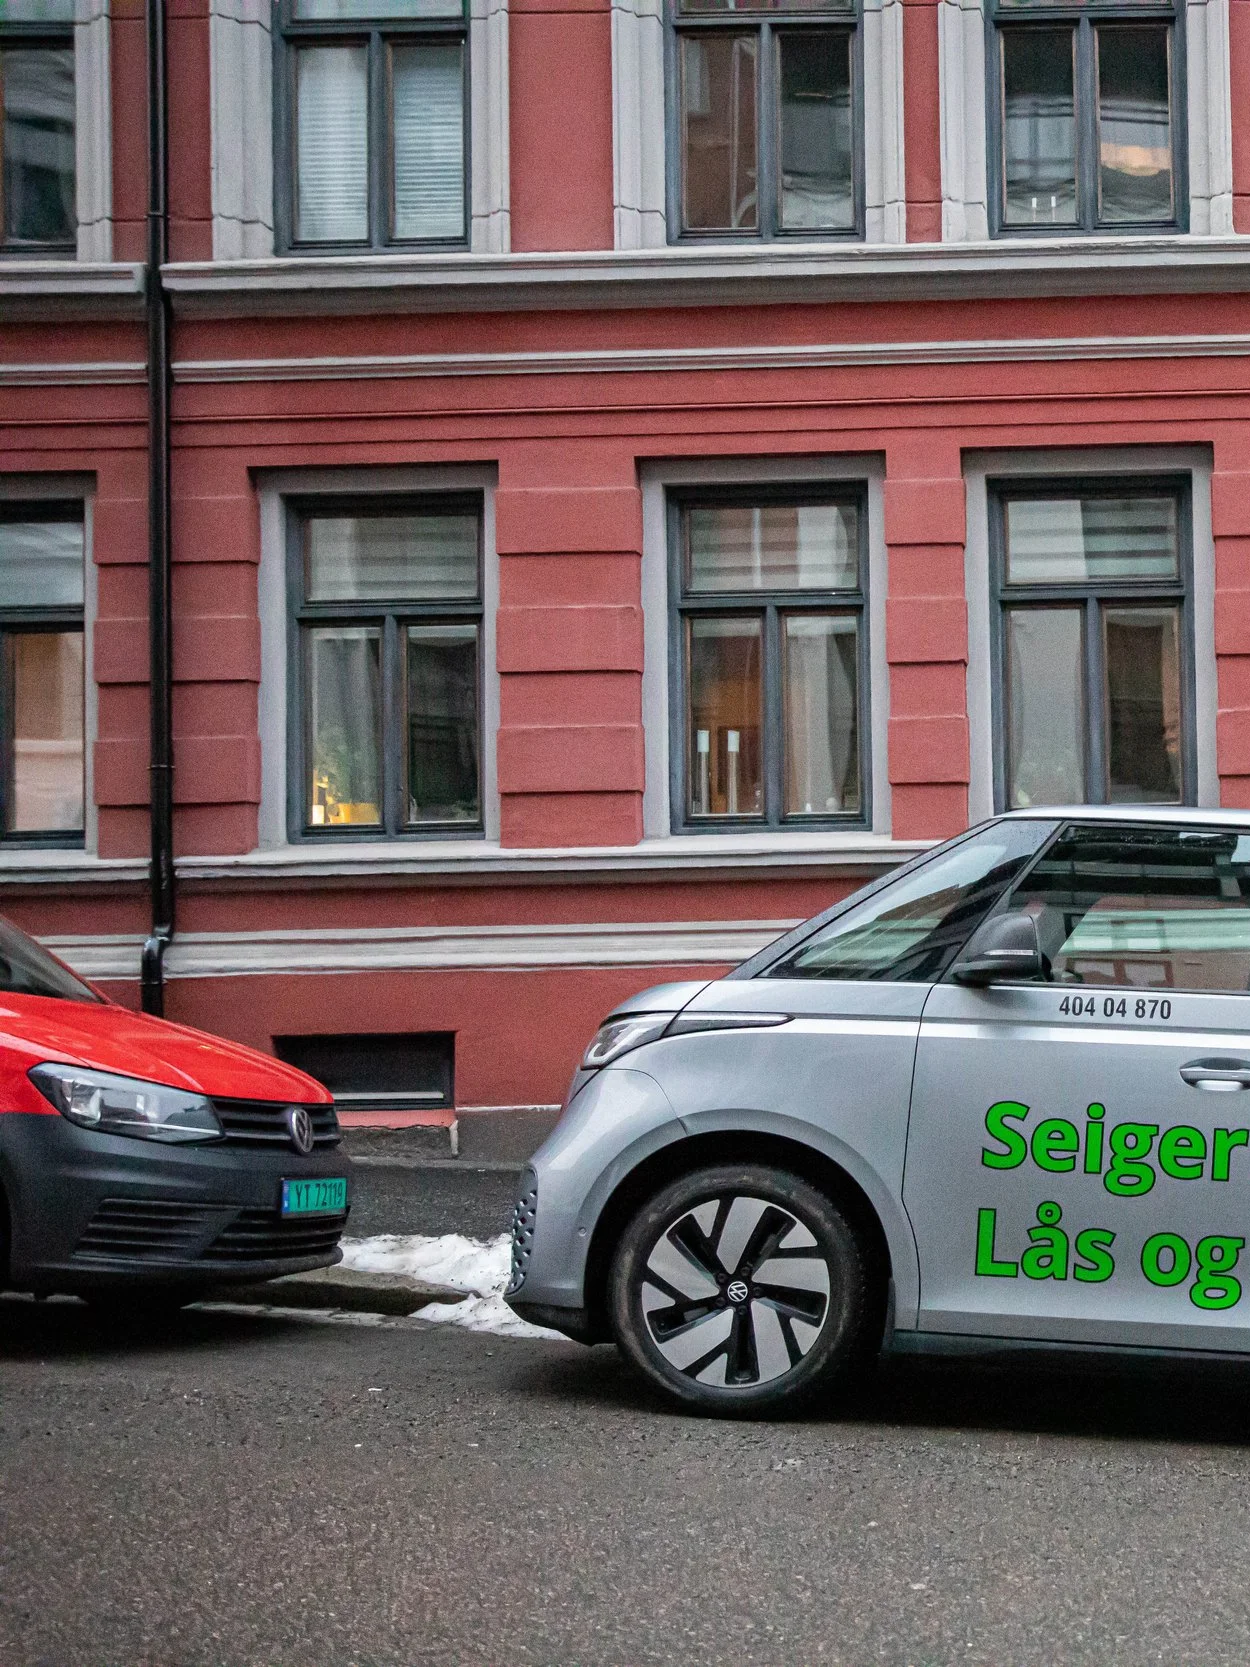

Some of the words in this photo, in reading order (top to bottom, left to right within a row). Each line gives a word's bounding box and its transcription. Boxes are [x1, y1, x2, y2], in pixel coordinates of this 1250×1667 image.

[1059, 996, 1096, 1017] 404
[1103, 997, 1127, 1018] 04
[1135, 999, 1172, 1020] 870
[295, 1183, 311, 1209] YT
[974, 1202, 1116, 1284] Lås
[1140, 1231, 1244, 1311] og
